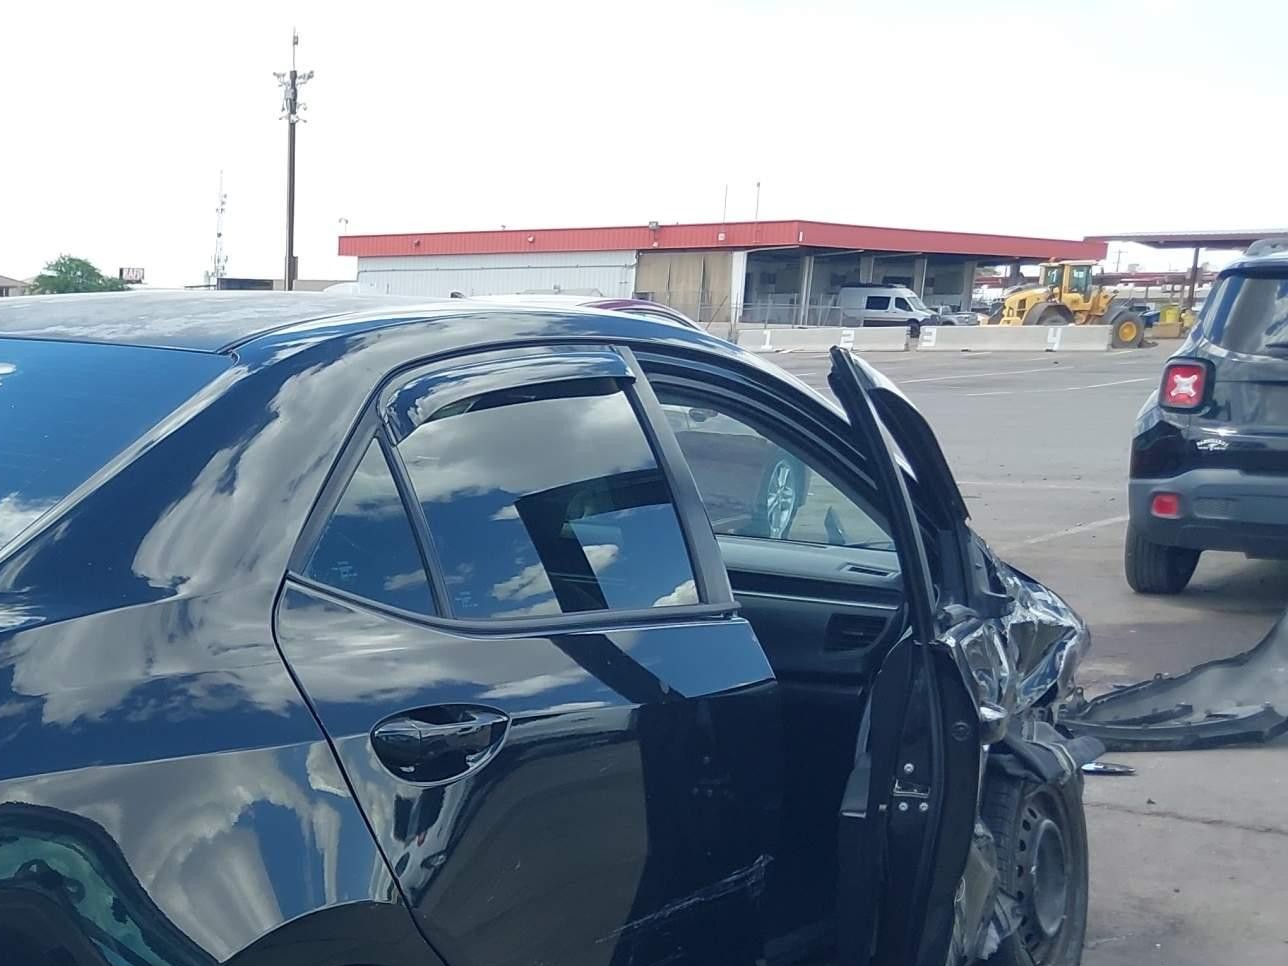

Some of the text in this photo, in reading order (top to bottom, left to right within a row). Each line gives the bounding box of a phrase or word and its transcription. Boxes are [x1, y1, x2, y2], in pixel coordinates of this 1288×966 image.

[761, 330, 772, 349] 1
[840, 329, 854, 349] 2
[922, 328, 936, 346] 3
